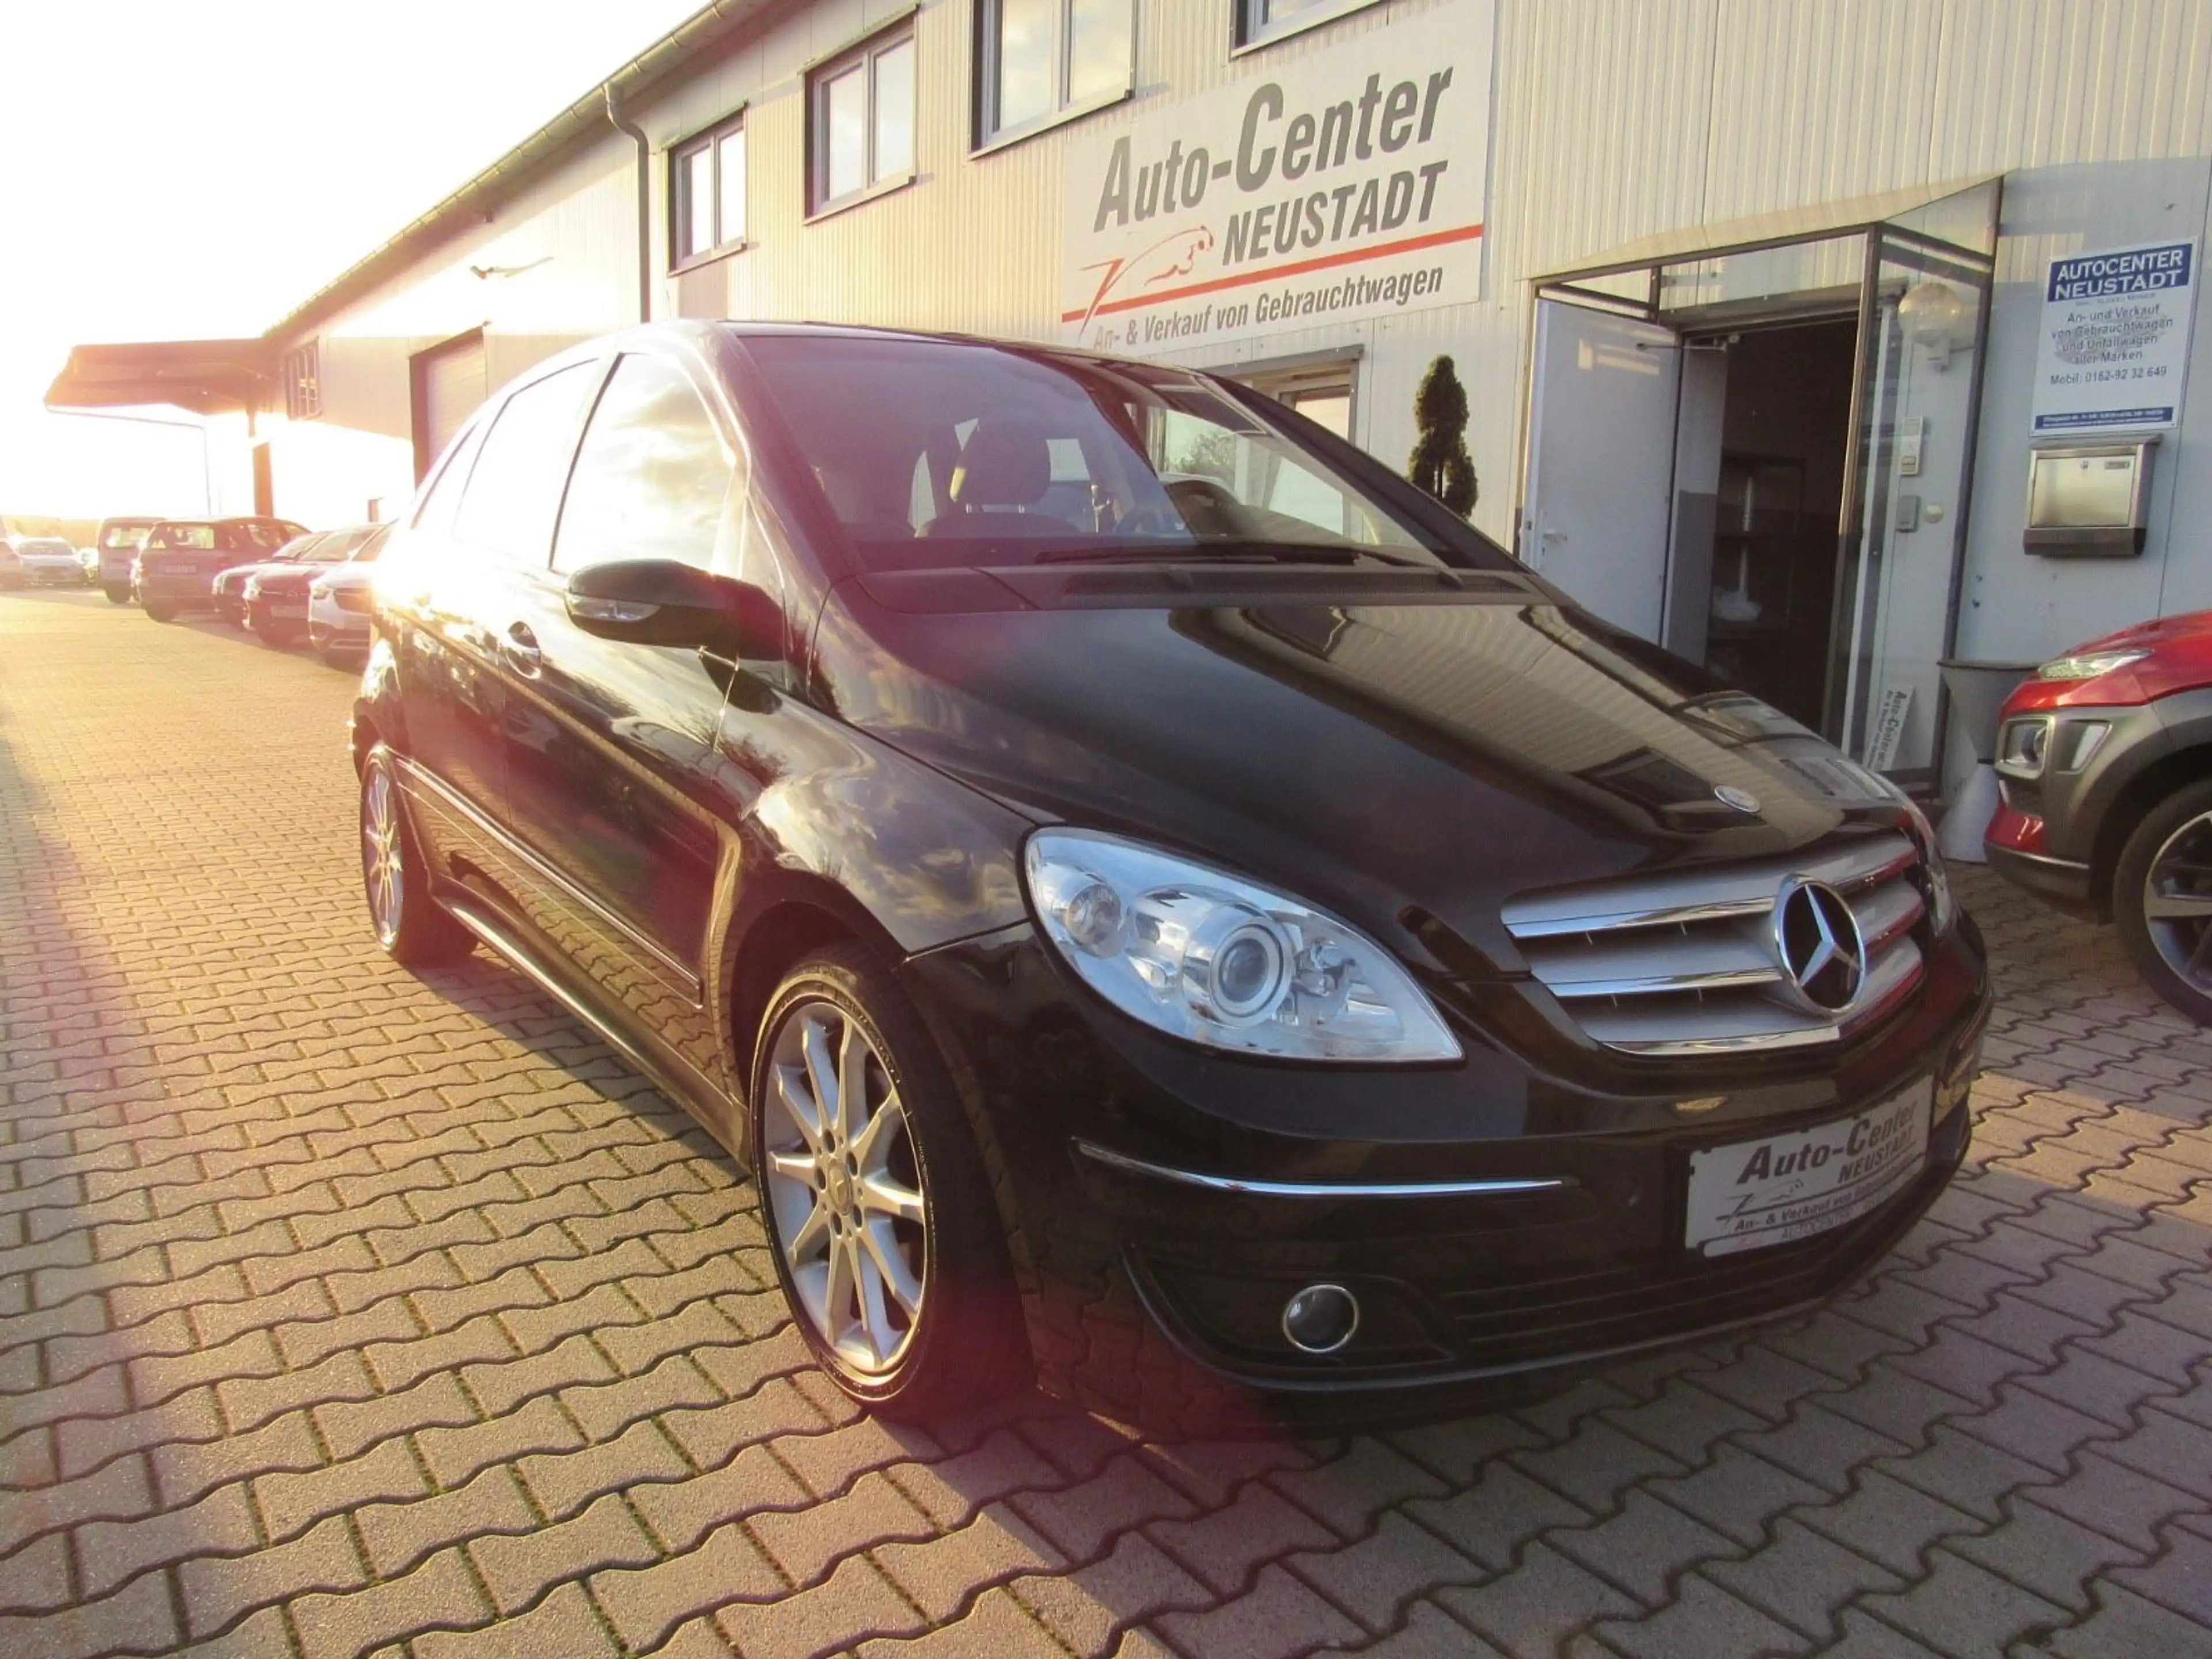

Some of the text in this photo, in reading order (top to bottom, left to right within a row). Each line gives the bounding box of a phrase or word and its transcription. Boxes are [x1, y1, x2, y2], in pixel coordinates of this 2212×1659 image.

[1093, 66, 1454, 233] Auto-Center
[1222, 160, 1449, 267] NEUSTADT
[2057, 249, 2184, 281] AUTOCENTER
[2055, 270, 2183, 300] NEUSTADT
[1093, 266, 1444, 351] An- & Verkauf von Gebrauchtwagen
[2090, 310, 2112, 321] und
[2115, 303, 2160, 319] Verkauf
[2051, 318, 2173, 339] von Gebrauchtwagen
[2062, 335, 2158, 352] und Unfallwagen
[2101, 350, 2143, 363] Marken
[1736, 1100, 1918, 1185] Auto-Center
